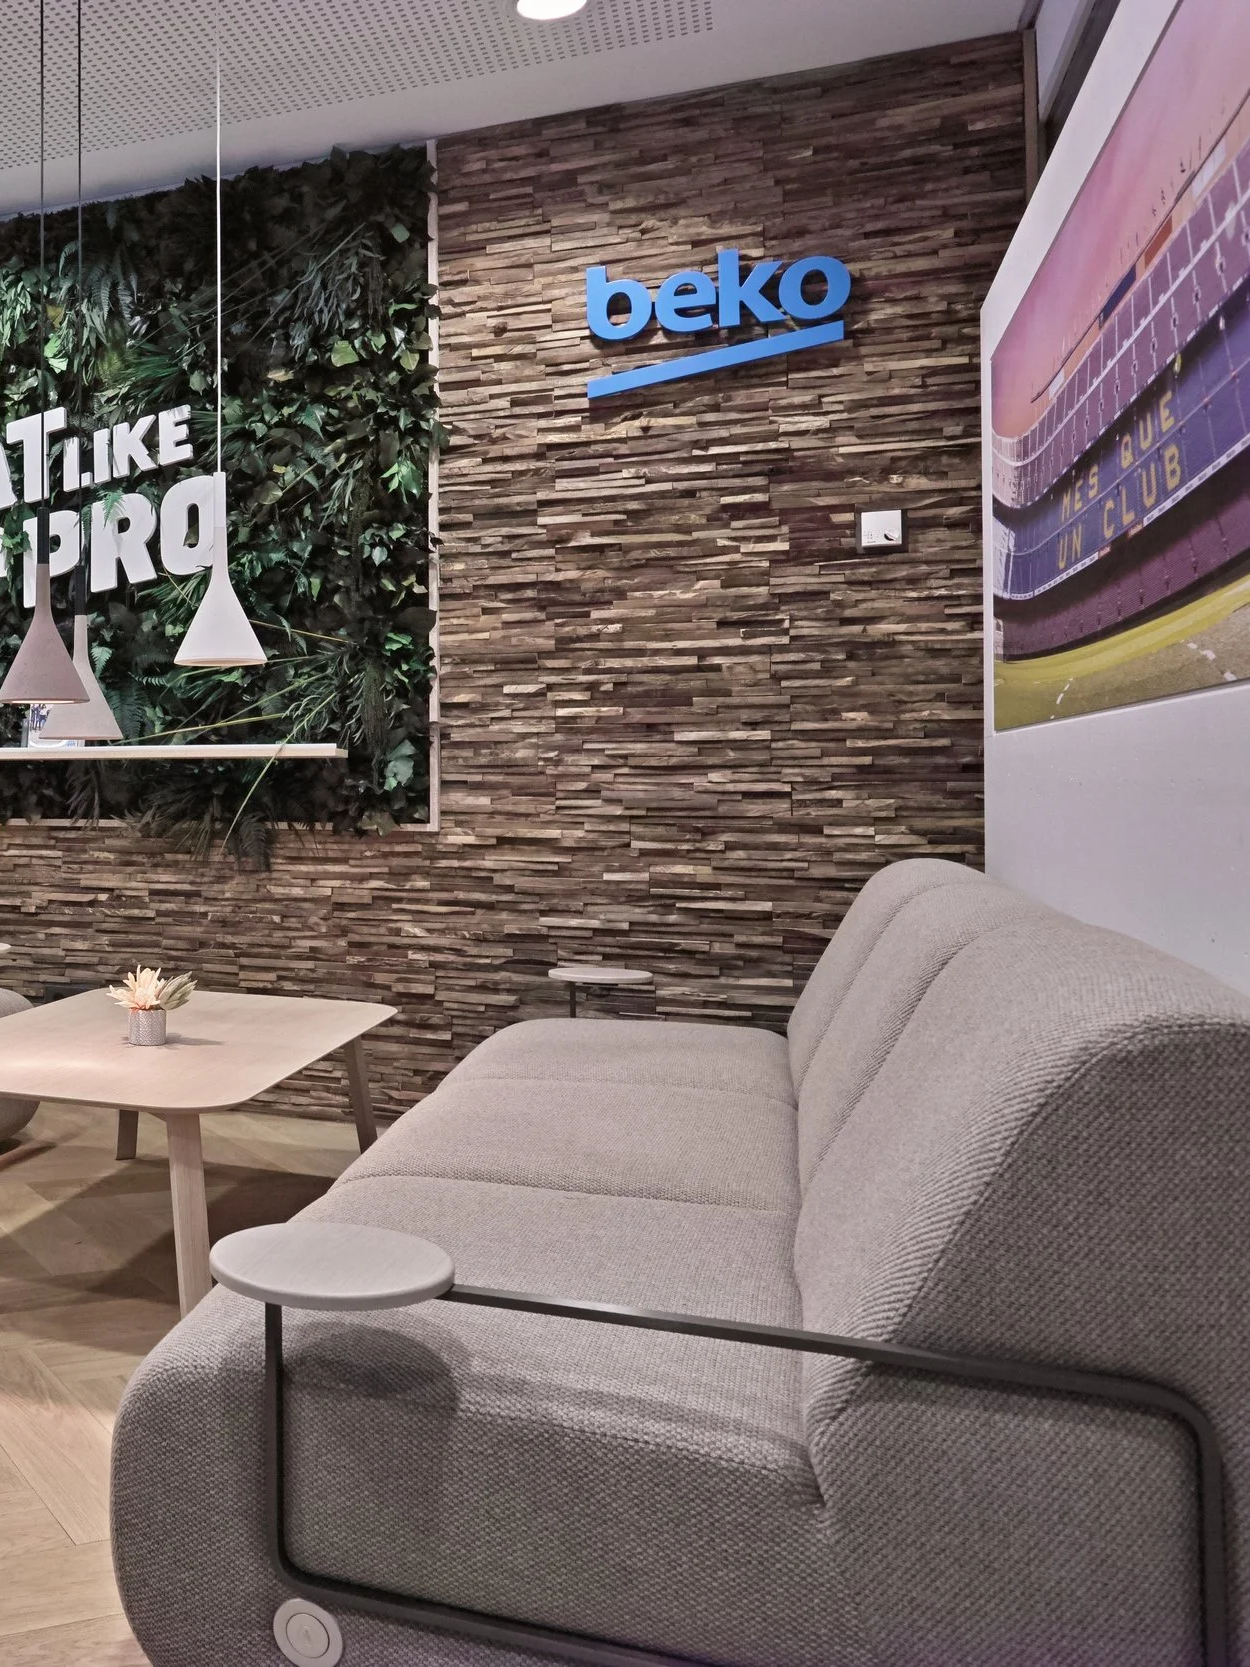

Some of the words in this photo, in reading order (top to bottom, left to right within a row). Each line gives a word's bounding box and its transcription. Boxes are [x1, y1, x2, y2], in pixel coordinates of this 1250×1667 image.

[586, 248, 851, 340] beko
[63, 404, 193, 492] LIKE
[1058, 523, 1083, 570] UN
[1103, 443, 1182, 540] CLUB
[1061, 464, 1099, 523] MES
[1120, 391, 1175, 470] QUE
[23, 475, 222, 608] PRO
